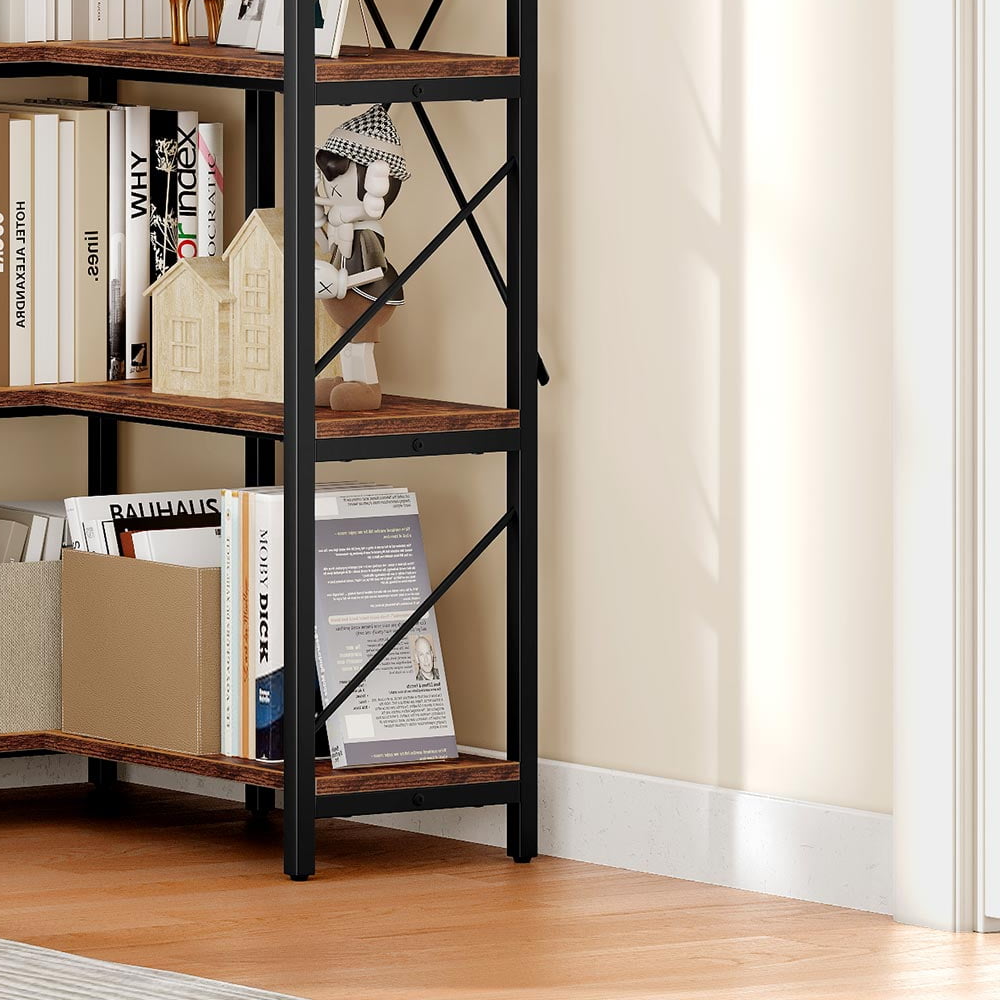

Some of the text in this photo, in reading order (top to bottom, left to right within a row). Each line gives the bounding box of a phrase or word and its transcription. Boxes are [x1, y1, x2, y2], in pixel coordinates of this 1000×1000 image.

[131, 150, 148, 219] WHY
[177, 126, 197, 217] index
[109, 497, 220, 520] BAUHAUS
[259, 529, 269, 664] MOBY DICK
